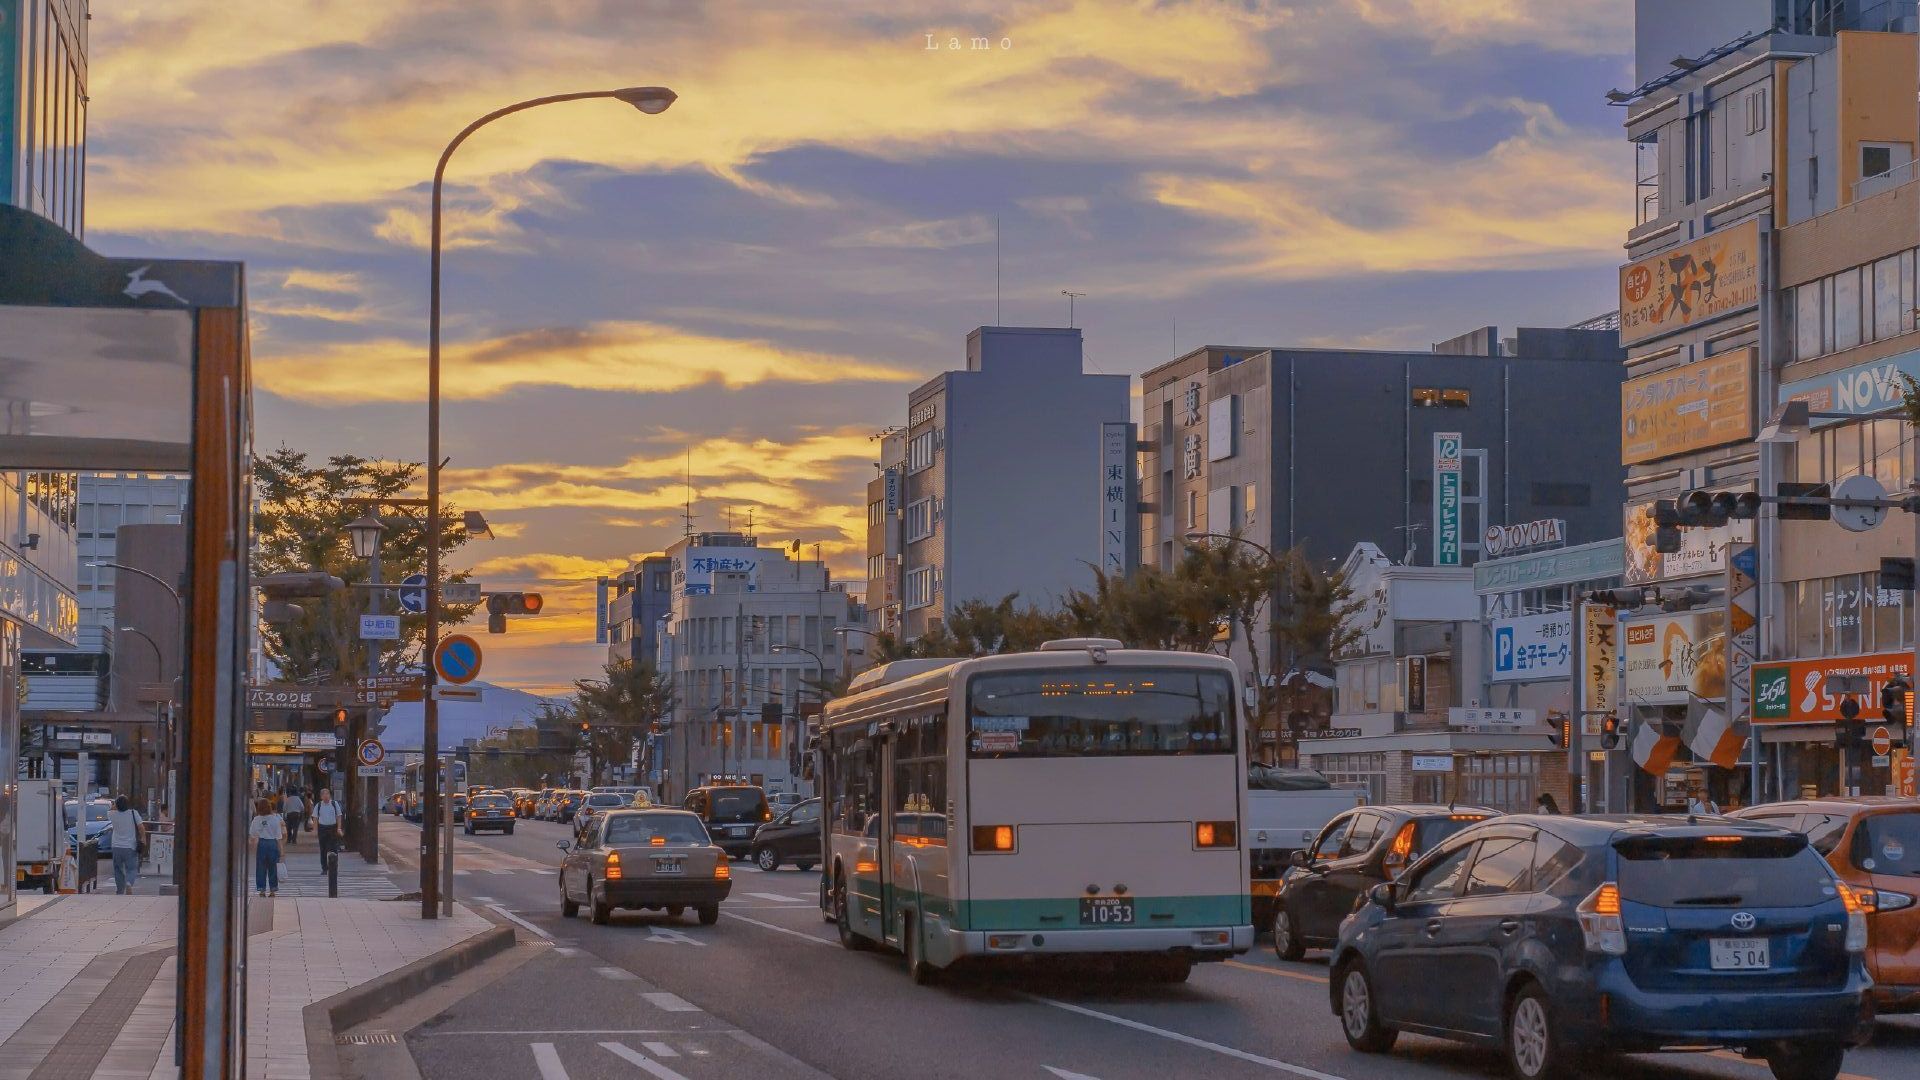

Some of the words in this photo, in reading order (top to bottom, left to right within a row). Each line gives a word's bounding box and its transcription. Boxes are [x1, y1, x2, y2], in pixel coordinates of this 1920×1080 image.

[1838, 364, 1906, 415] NOVA
[1442, 474, 1457, 563] トヨタレンタカー
[1505, 521, 1557, 549] TOYOTA
[1518, 642, 1572, 669] 金子モータ
[251, 691, 313, 703] バスのりば
[1092, 905, 1132, 923] 10-53
